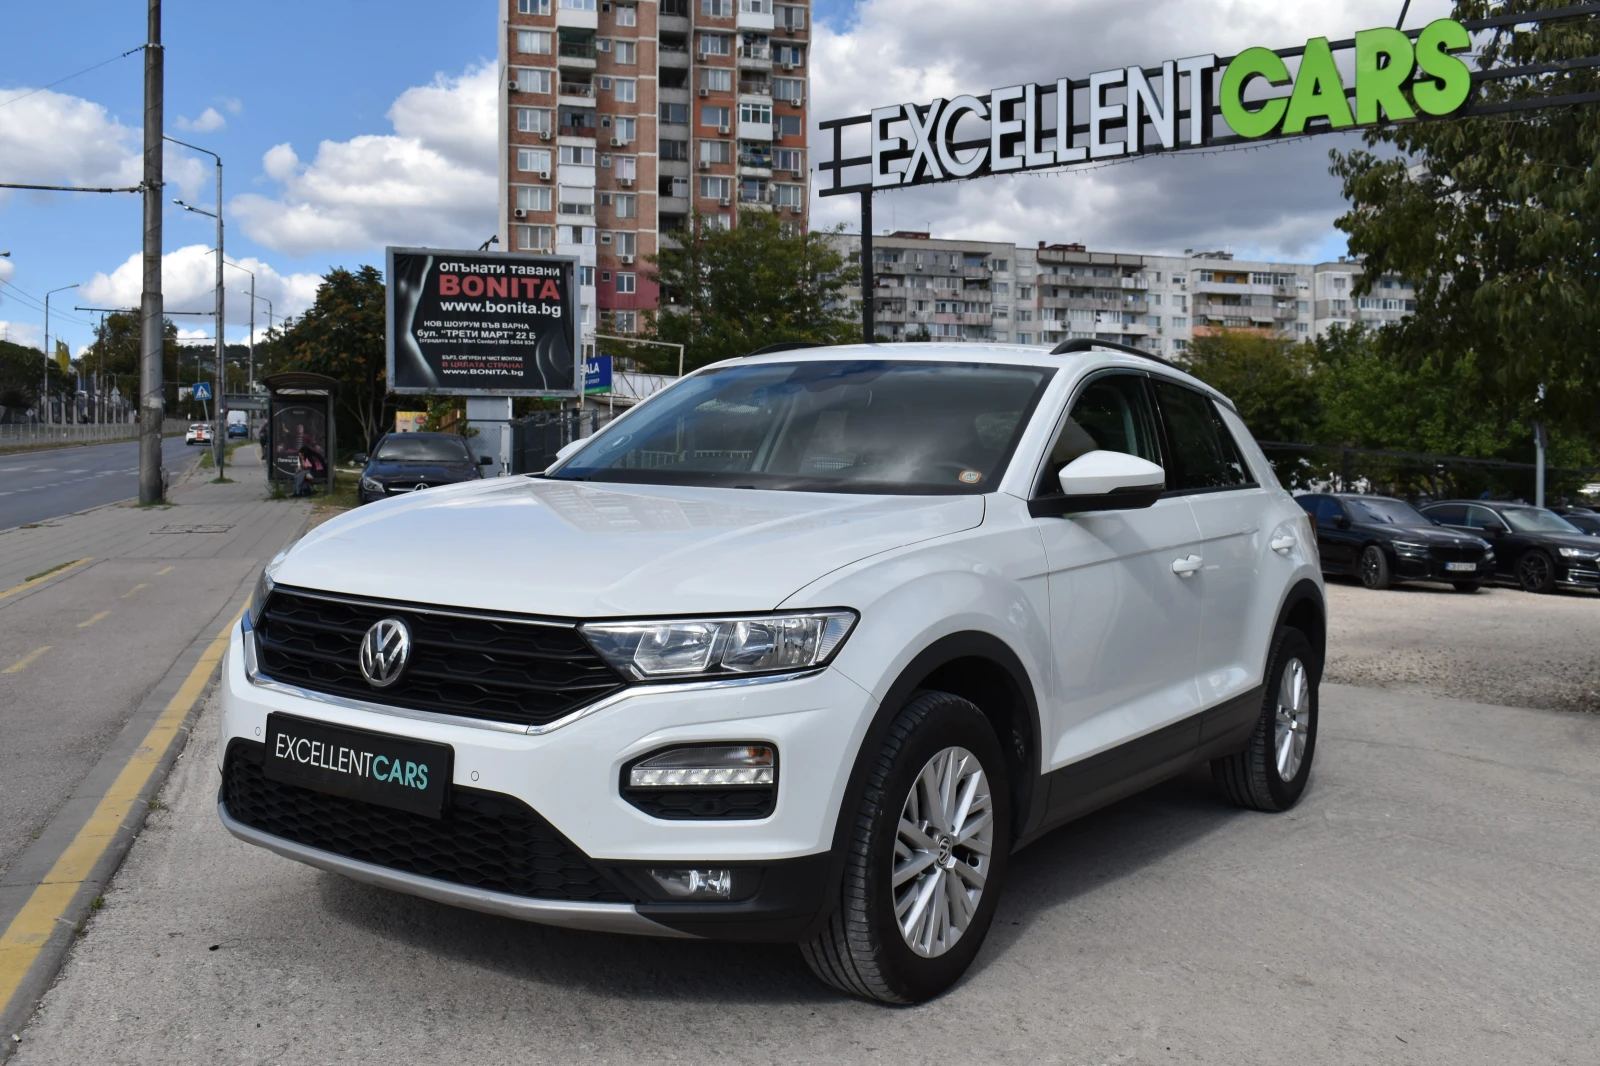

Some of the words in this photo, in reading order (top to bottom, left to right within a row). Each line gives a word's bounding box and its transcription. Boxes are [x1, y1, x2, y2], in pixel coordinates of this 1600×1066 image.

[439, 262, 506, 274] опънати
[509, 264, 560, 277] тавани
[439, 274, 560, 300] BONITA
[440, 300, 562, 318] www.bonita.bg
[417, 329, 439, 339] бул.
[442, 368, 524, 377] www.BONITA.bg
[450, 361, 485, 369] ЦЯЛАТА
[275, 733, 428, 790] EXCELLENTCARS
